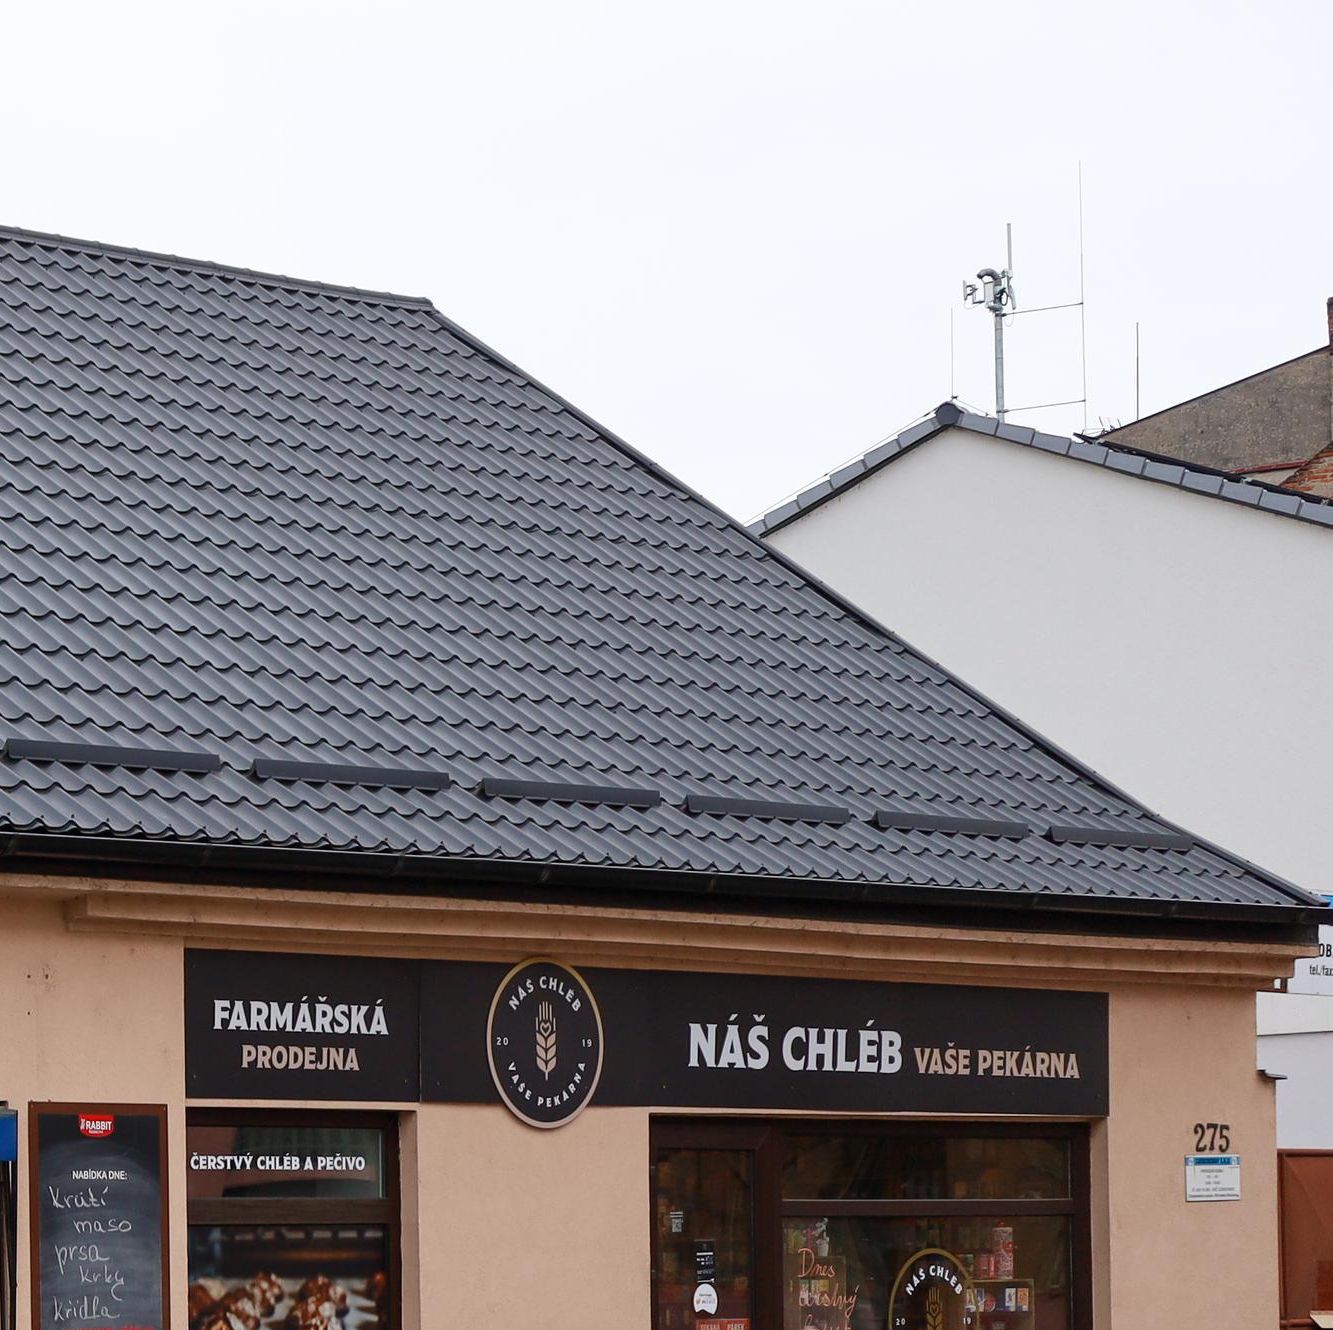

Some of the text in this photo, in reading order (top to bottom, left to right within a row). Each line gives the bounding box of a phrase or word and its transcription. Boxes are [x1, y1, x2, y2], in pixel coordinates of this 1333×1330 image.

[213, 995, 389, 1035] FARMÁŘSKÁ
[496, 1037, 509, 1046] 20
[582, 1039, 593, 1047] 19
[688, 1013, 1081, 1079] NÁŠ CHLÉB VAŠE PEKÁRNA
[241, 1044, 360, 1071] PRODEJNA
[85, 1121, 113, 1131] RABBIT
[1193, 1123, 1230, 1153] 275
[190, 1152, 366, 1171] ČERSTVÝ CHLÉB A PEČIVO
[72, 1168, 128, 1180] NABÍDKA DNE:
[73, 1218, 132, 1234] maso
[54, 1244, 110, 1276] prsa
[797, 1247, 836, 1278] Dnes
[895, 1318, 906, 1326] 20
[963, 1317, 972, 1325] 19
